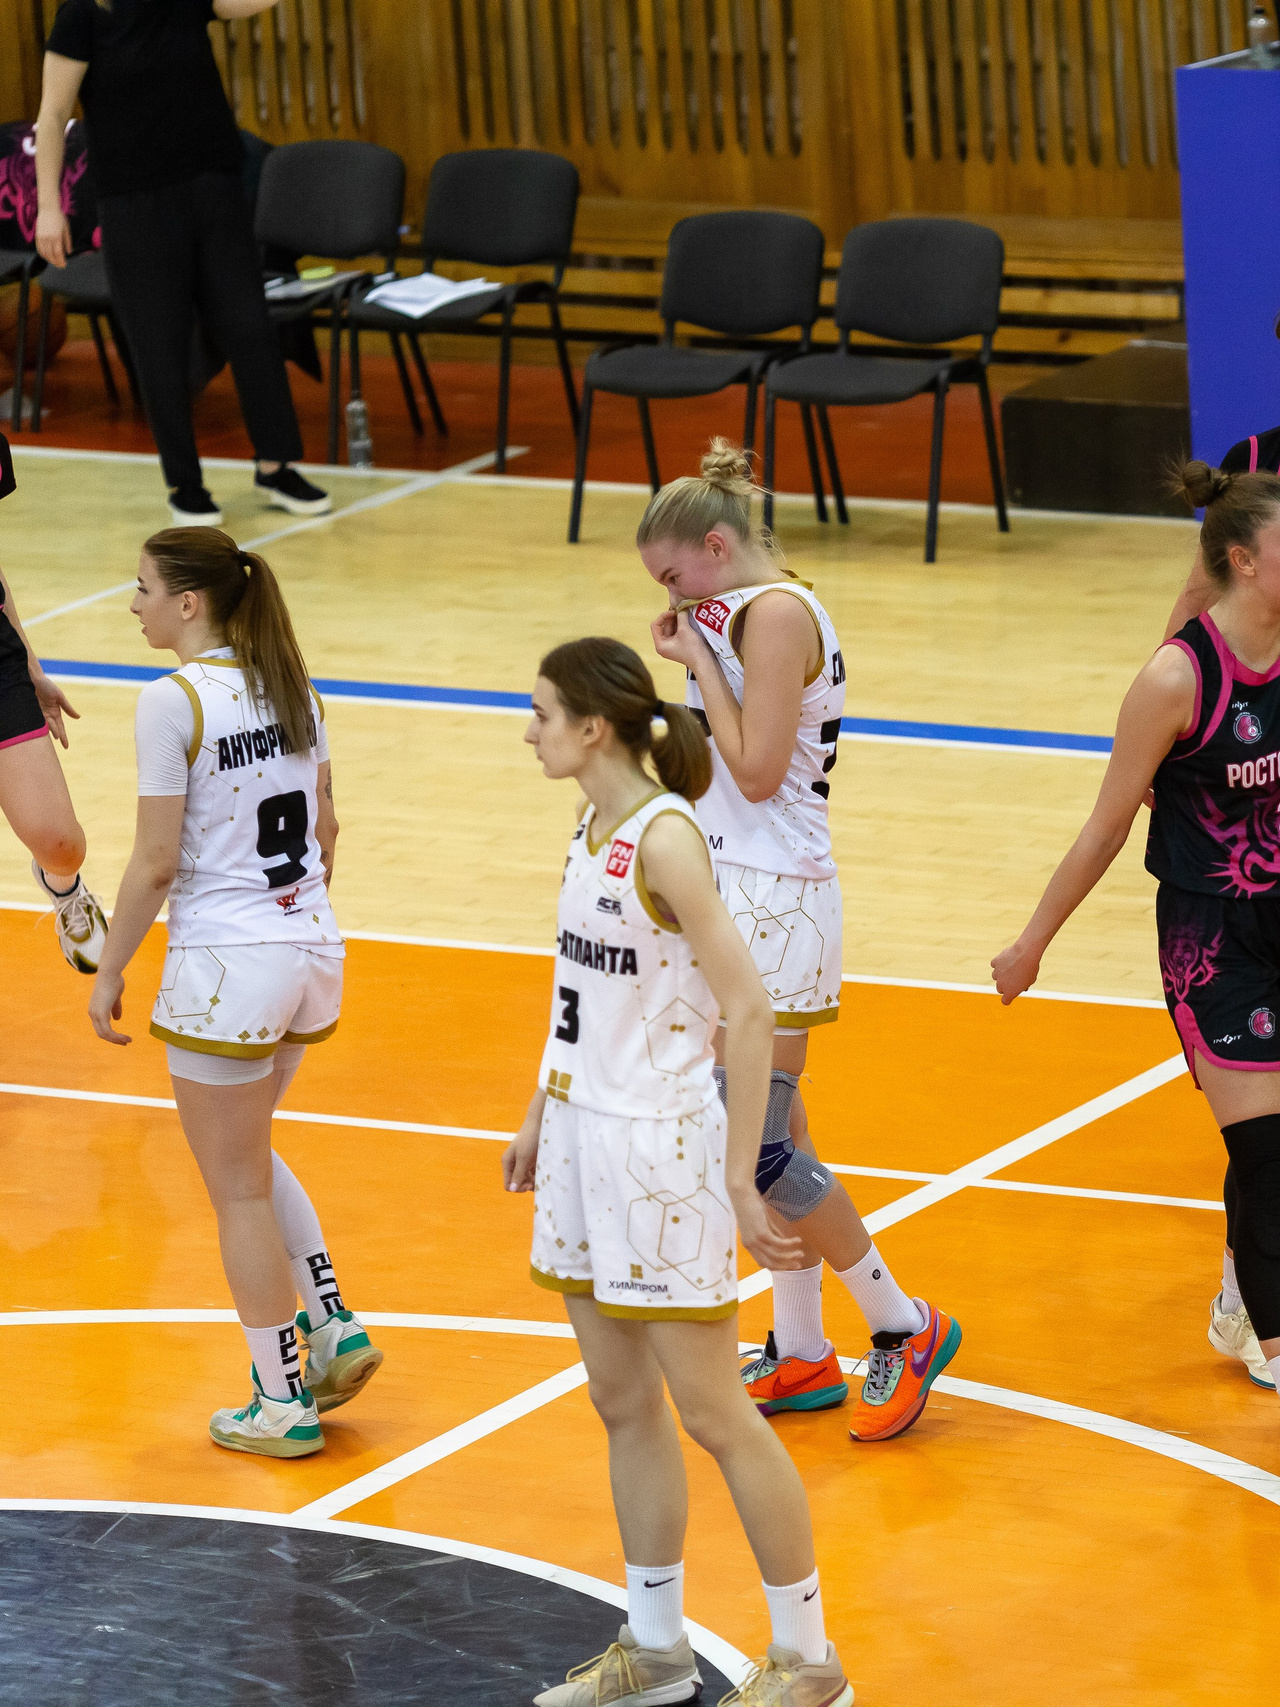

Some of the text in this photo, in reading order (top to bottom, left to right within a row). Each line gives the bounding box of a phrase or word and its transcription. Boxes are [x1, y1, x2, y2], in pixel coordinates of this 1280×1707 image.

[697, 608, 723, 630] BET
[256, 789, 308, 889] 9
[555, 985, 579, 1045] 3
[608, 1280, 669, 1293] ХИМПРОМ
